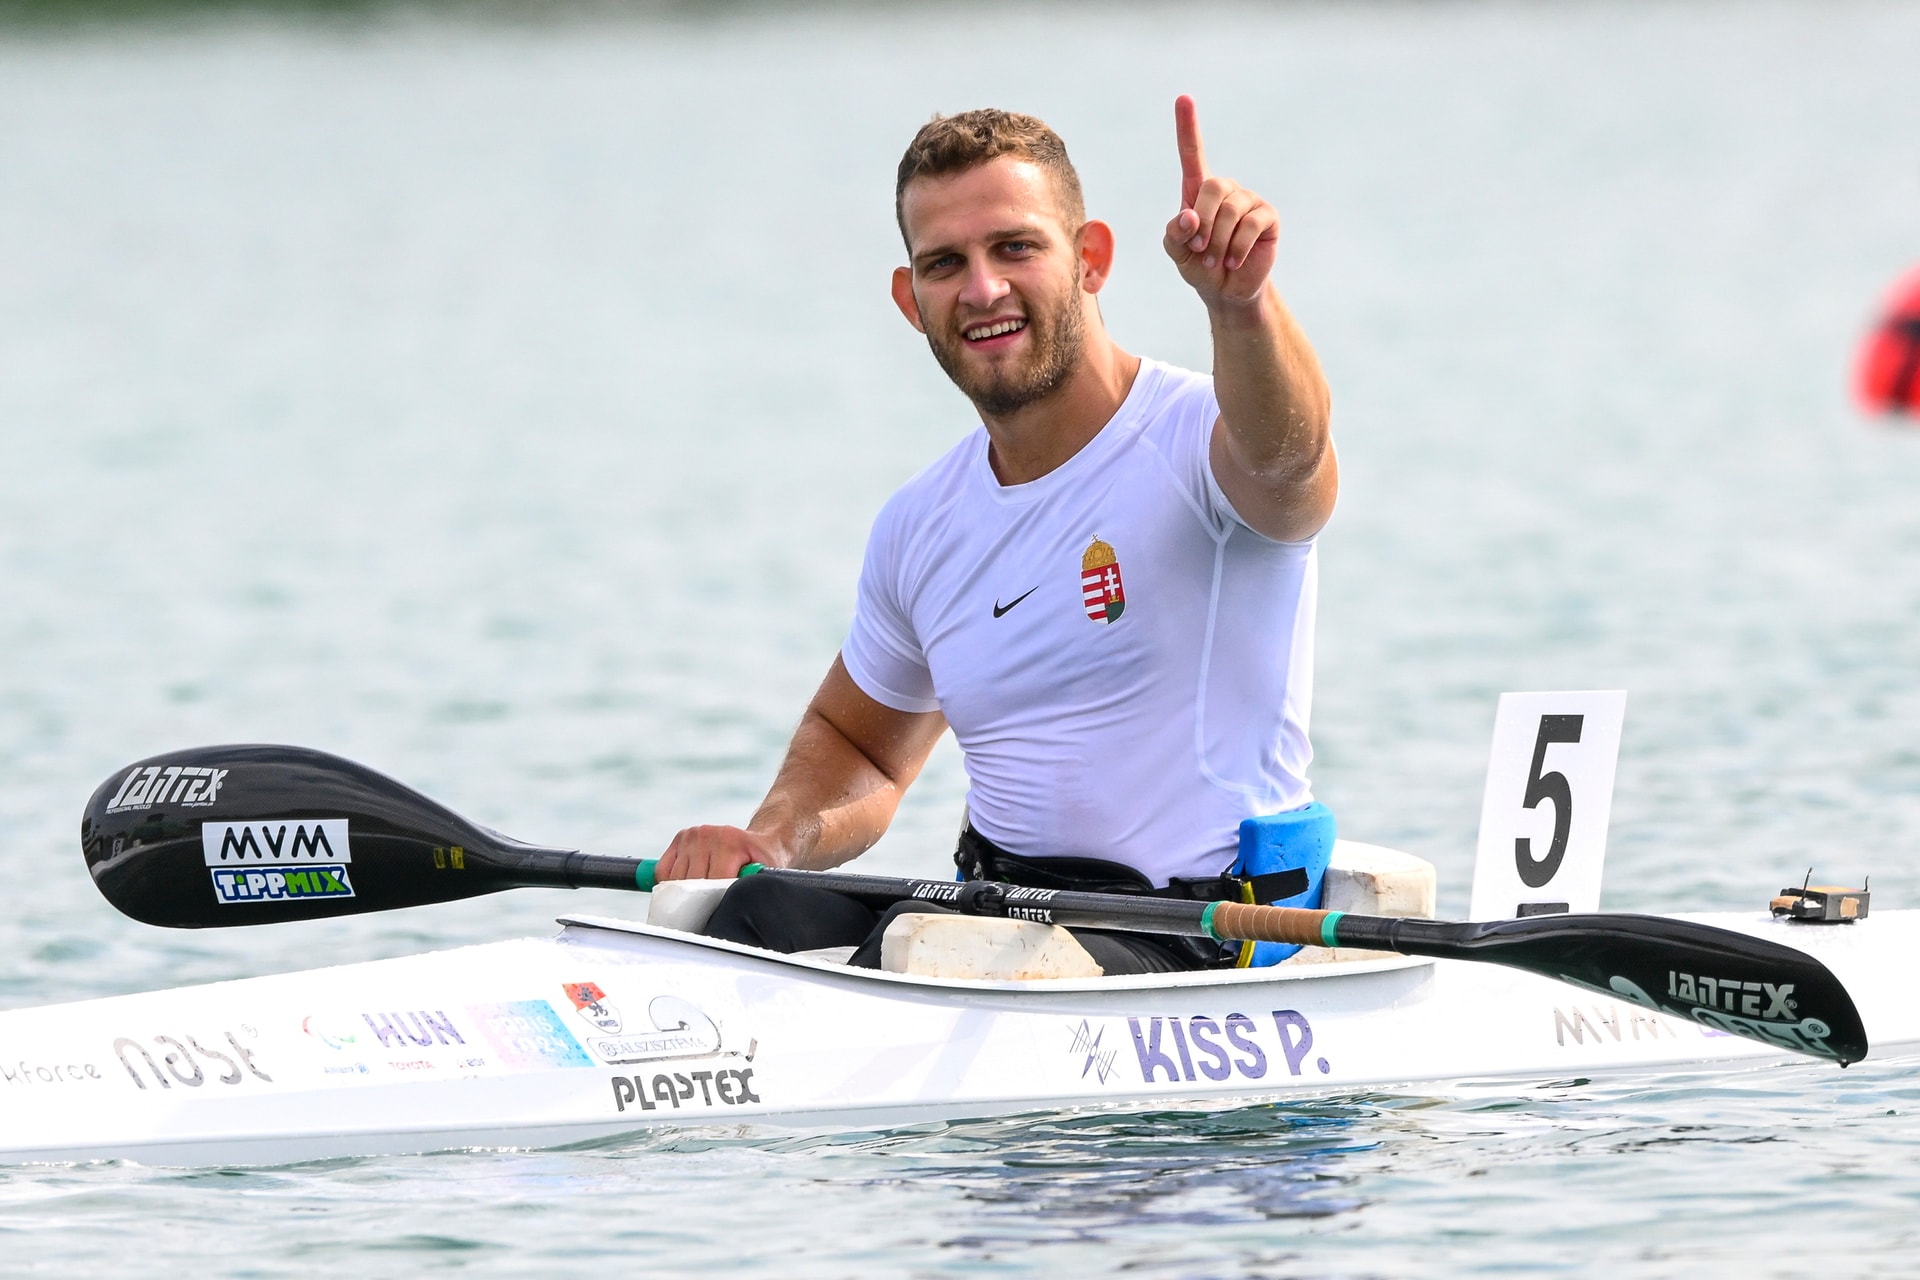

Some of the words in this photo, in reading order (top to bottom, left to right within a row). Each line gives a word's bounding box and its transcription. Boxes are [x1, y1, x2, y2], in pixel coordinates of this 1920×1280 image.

[1515, 714, 1584, 888] 5
[220, 825, 334, 860] MVM
[361, 1010, 466, 1048] HUN
[1127, 1013, 1267, 1082] KISS
[1272, 1010, 1331, 1077] P.
[611, 1068, 760, 1112] PLASTEX
